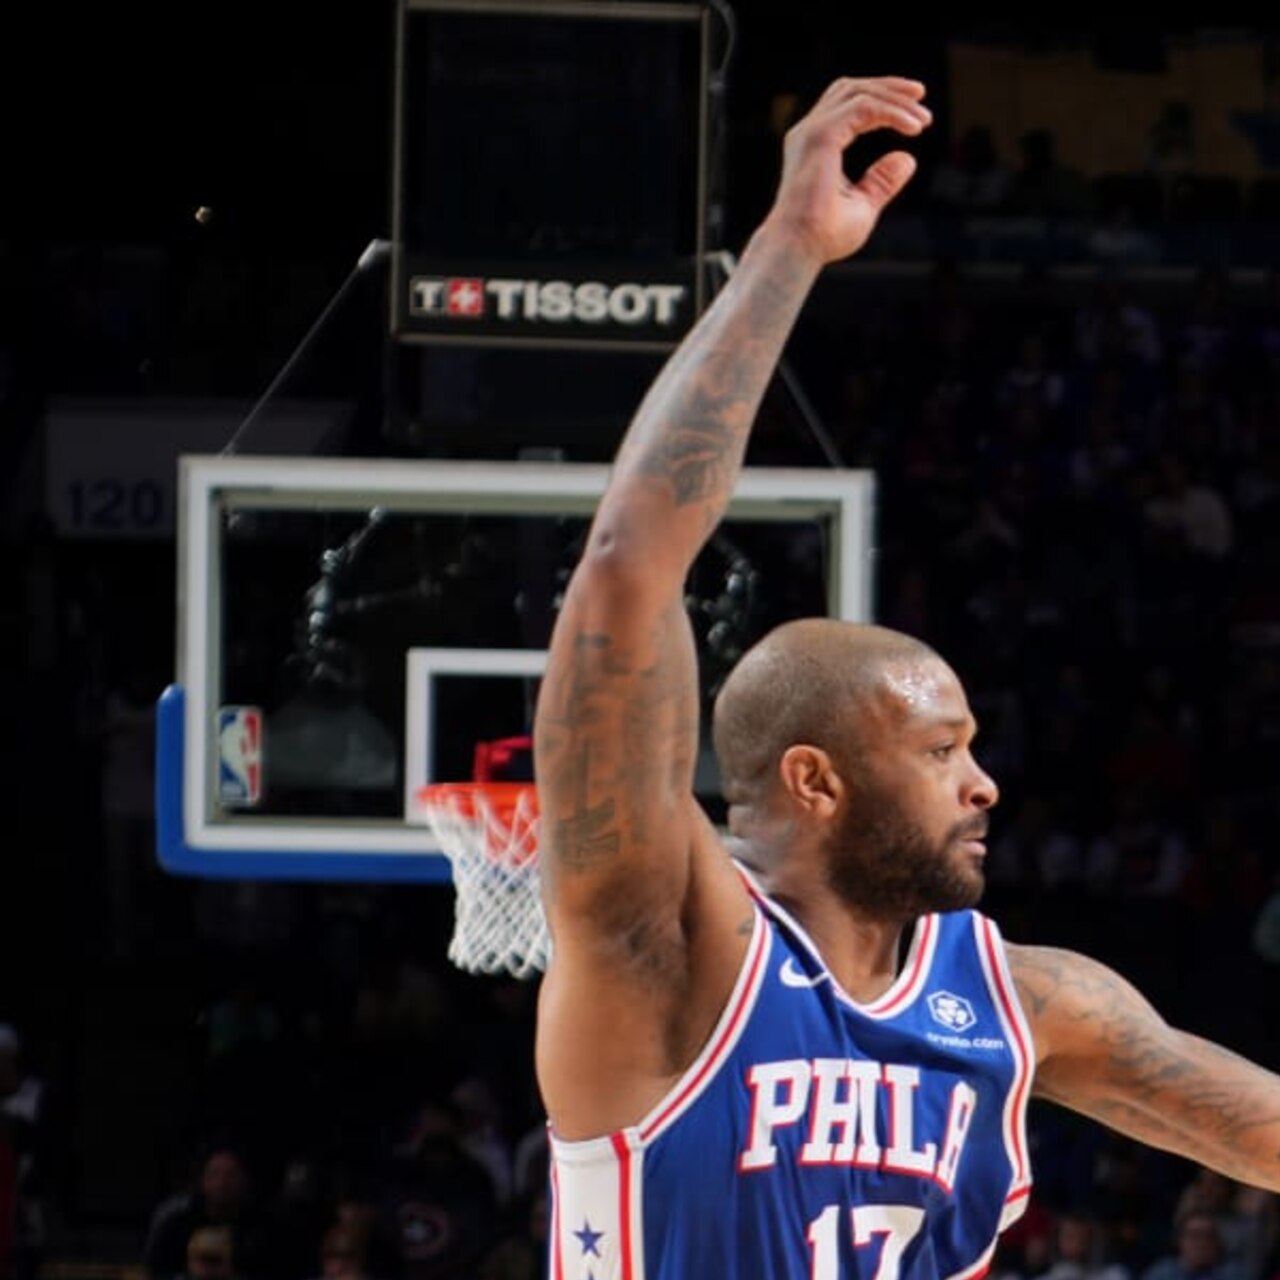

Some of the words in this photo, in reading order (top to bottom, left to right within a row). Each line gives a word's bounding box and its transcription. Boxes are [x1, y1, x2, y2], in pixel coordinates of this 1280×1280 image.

[486, 280, 684, 324] TISSOT
[70, 480, 163, 526] 120
[738, 1058, 976, 1194] PHILA
